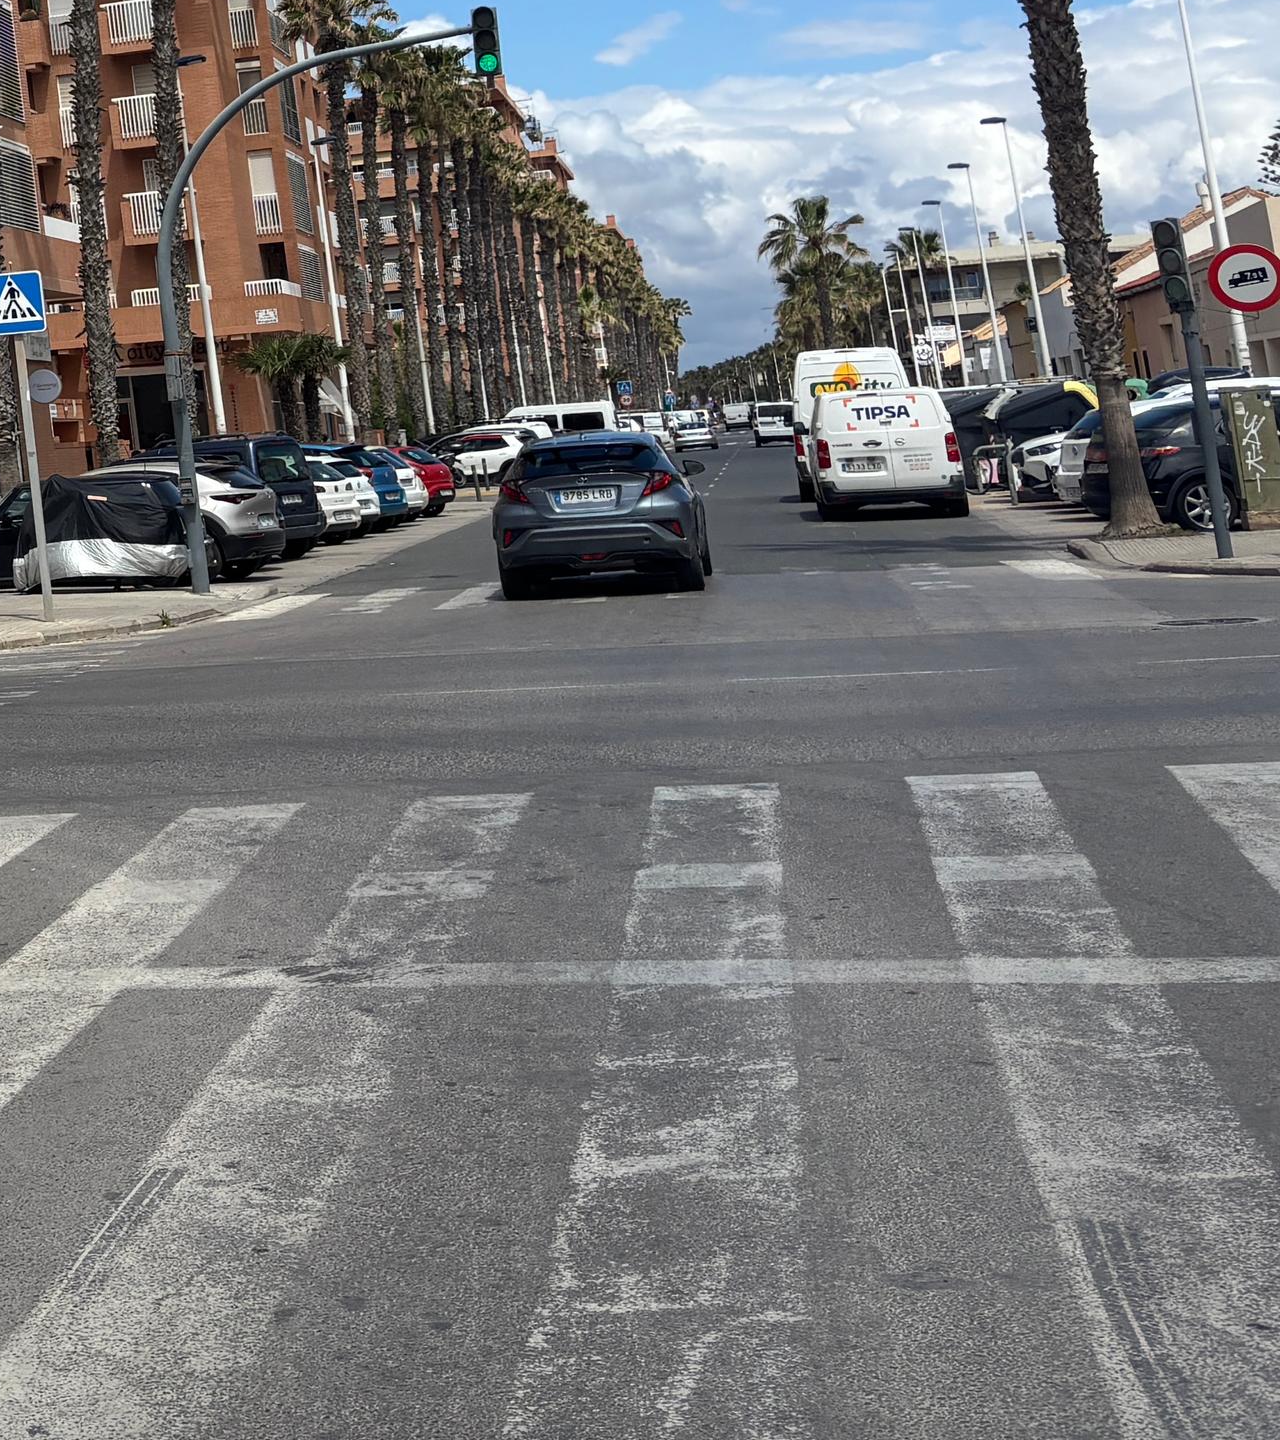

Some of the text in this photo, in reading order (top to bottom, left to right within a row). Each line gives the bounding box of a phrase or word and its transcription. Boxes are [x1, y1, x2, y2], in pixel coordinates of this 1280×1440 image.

[851, 405, 910, 421] TIPSA
[562, 489, 613, 500] 9785 LRB
